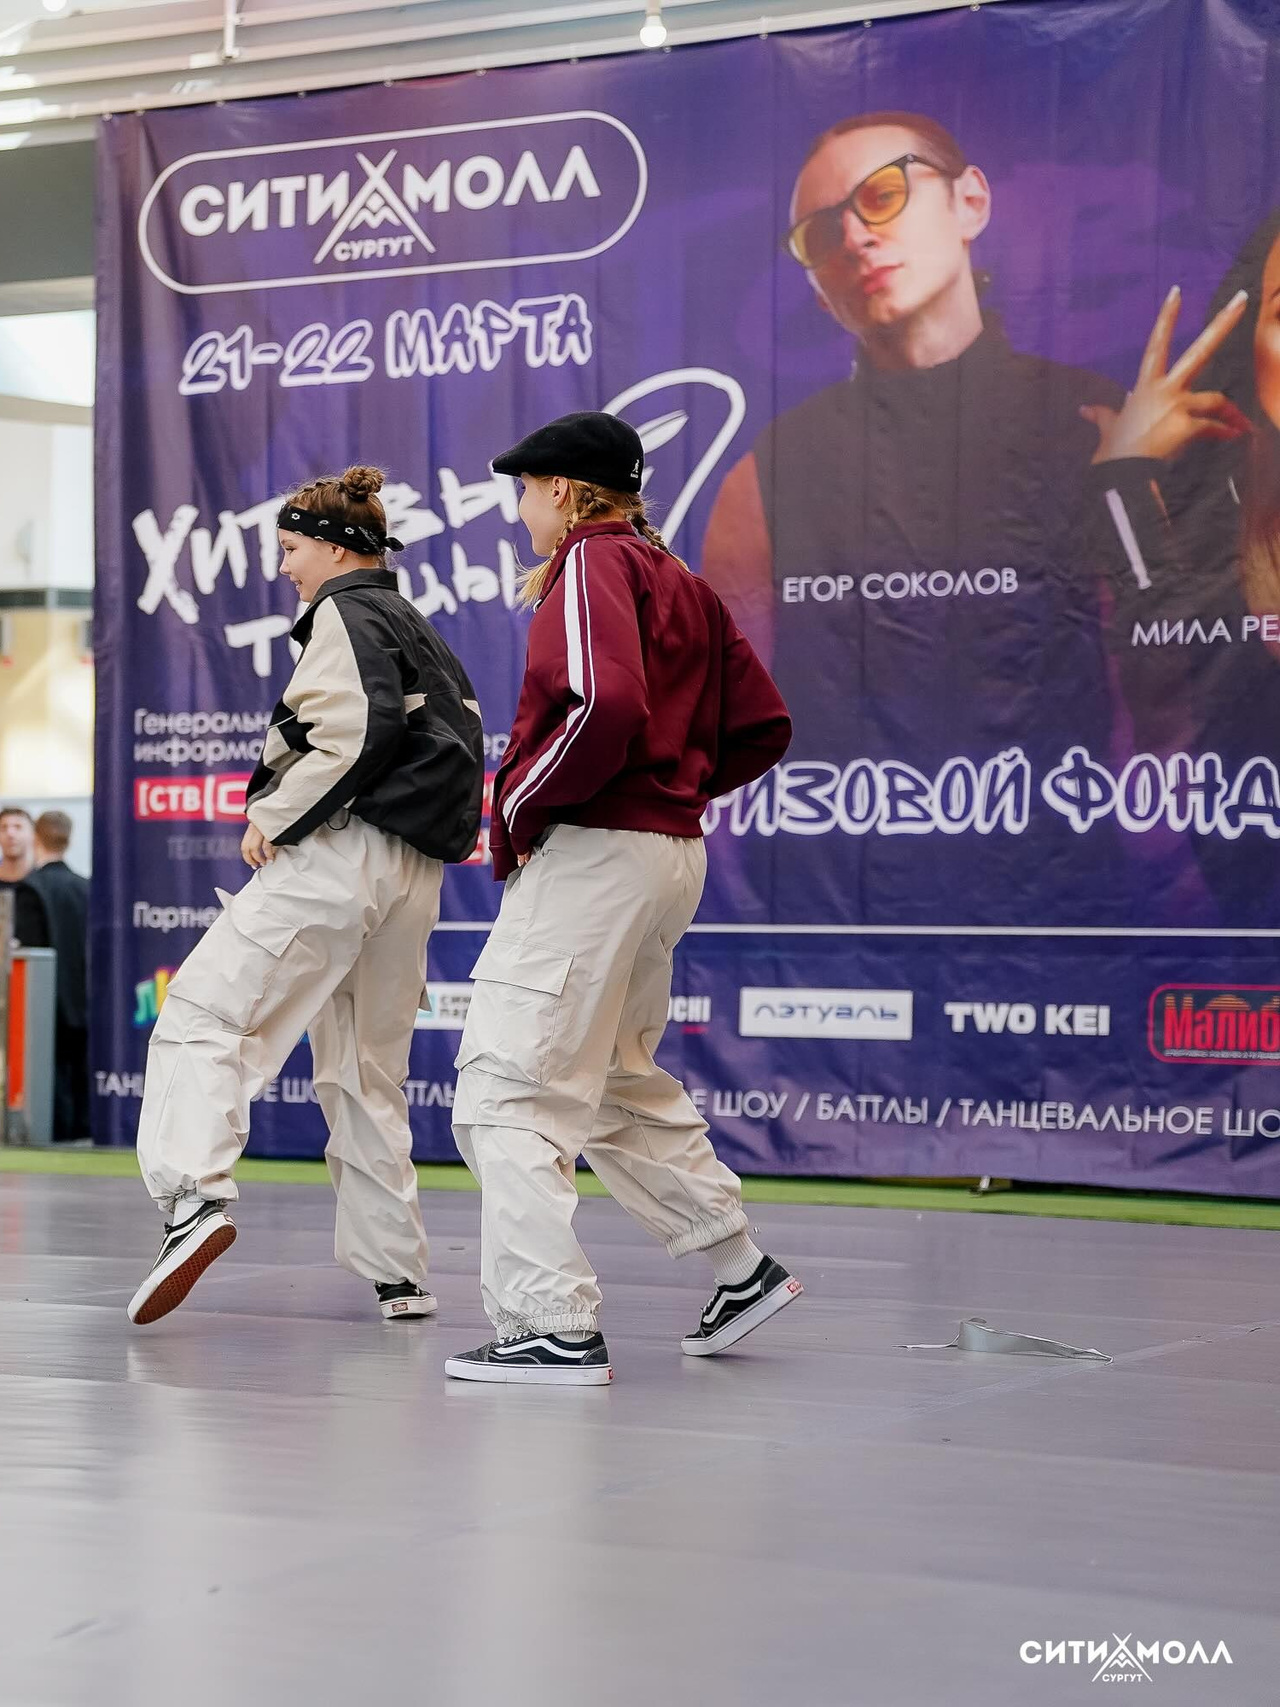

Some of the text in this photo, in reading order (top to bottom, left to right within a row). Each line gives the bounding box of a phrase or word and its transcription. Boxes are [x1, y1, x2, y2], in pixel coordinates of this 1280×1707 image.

[179, 146, 601, 237] СИТИ МОЛЛ
[335, 235, 416, 262] СУРГУТ
[178, 294, 593, 396] 21-22 МАРТА
[783, 567, 1018, 603] ЕГОР СОКОЛОВ
[223, 538, 519, 678] ТЦЫ
[1131, 614, 1280, 646] МИЛА РЕ
[134, 708, 269, 738] Генеральн
[701, 747, 1031, 836] ИЗОВОЙ
[133, 901, 222, 933] Партне
[944, 1002, 1110, 1036] TWO KEI
[1164, 994, 1280, 1052] Малиб
[712, 1090, 788, 1119] ШОУ
[816, 1093, 928, 1124] БАТТЛЫ
[959, 1098, 1213, 1135] ТАНЦЕВАЛЬНОЕ
[1223, 1107, 1280, 1138] ШО
